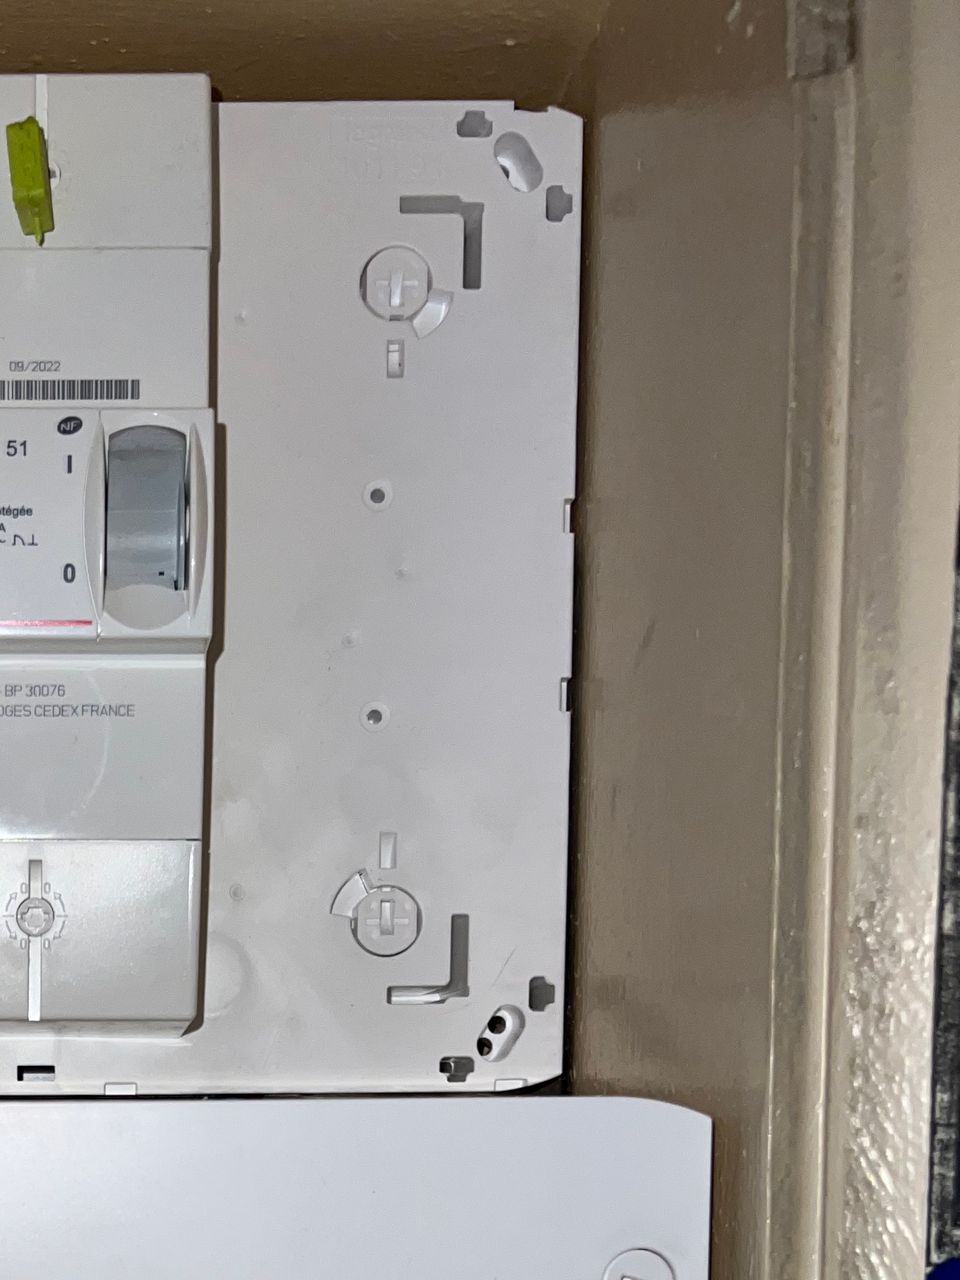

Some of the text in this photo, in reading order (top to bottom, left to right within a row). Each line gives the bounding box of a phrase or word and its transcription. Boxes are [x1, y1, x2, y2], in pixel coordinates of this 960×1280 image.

[9, 361, 61, 372] 09/2022
[6, 440, 28, 456] 51
[63, 563, 76, 583] 0
[5, 684, 23, 697] BP
[25, 684, 66, 697] 30076
[34, 705, 79, 717] CEDEX
[81, 704, 135, 717] FRANCE
